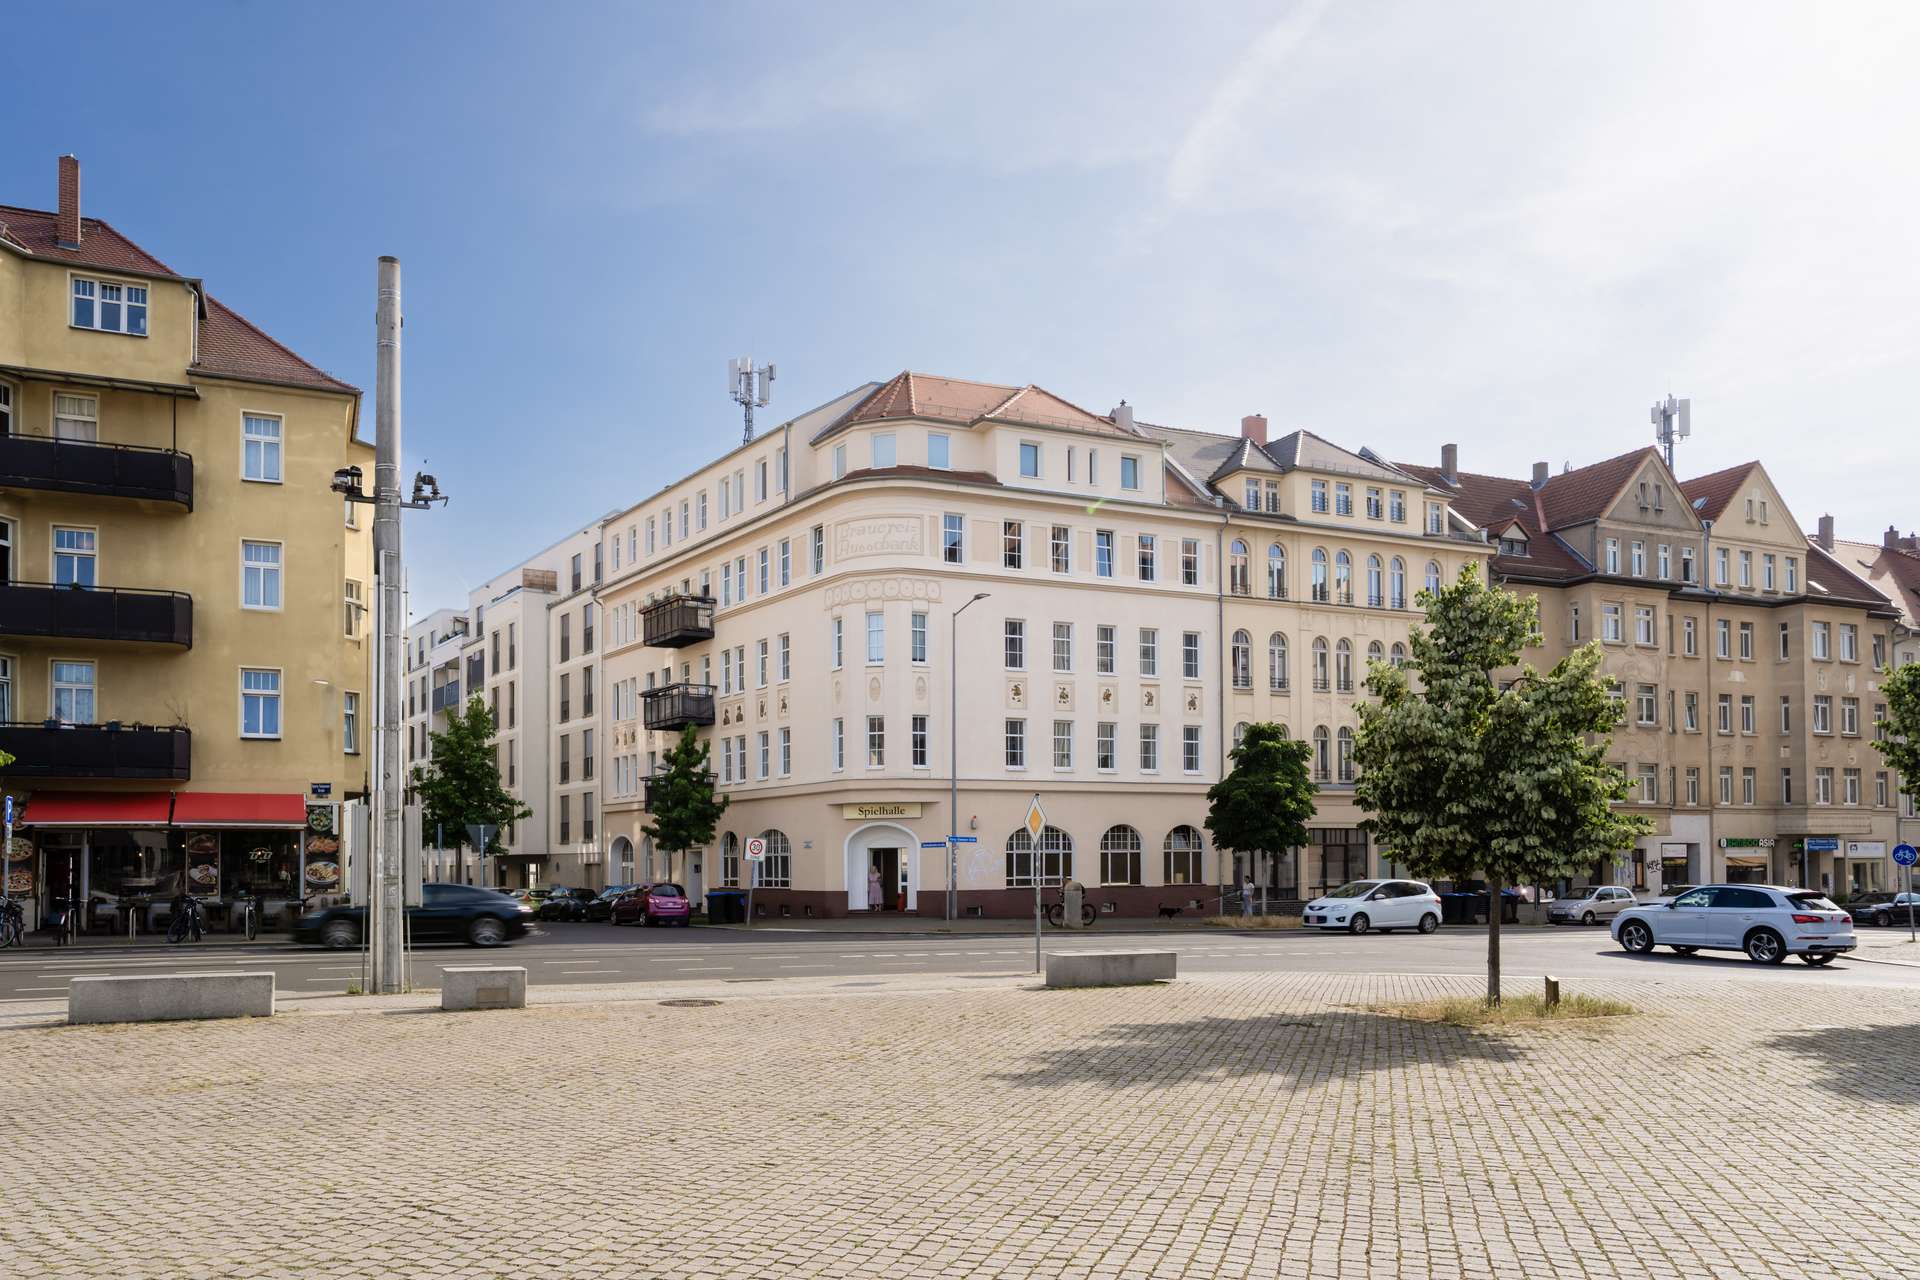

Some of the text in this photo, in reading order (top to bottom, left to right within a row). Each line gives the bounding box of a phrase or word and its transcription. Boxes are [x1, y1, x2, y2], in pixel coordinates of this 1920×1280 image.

[858, 806, 906, 818] Spielhalle
[751, 843, 761, 851] 30
[1759, 838, 1775, 848] ASIA
